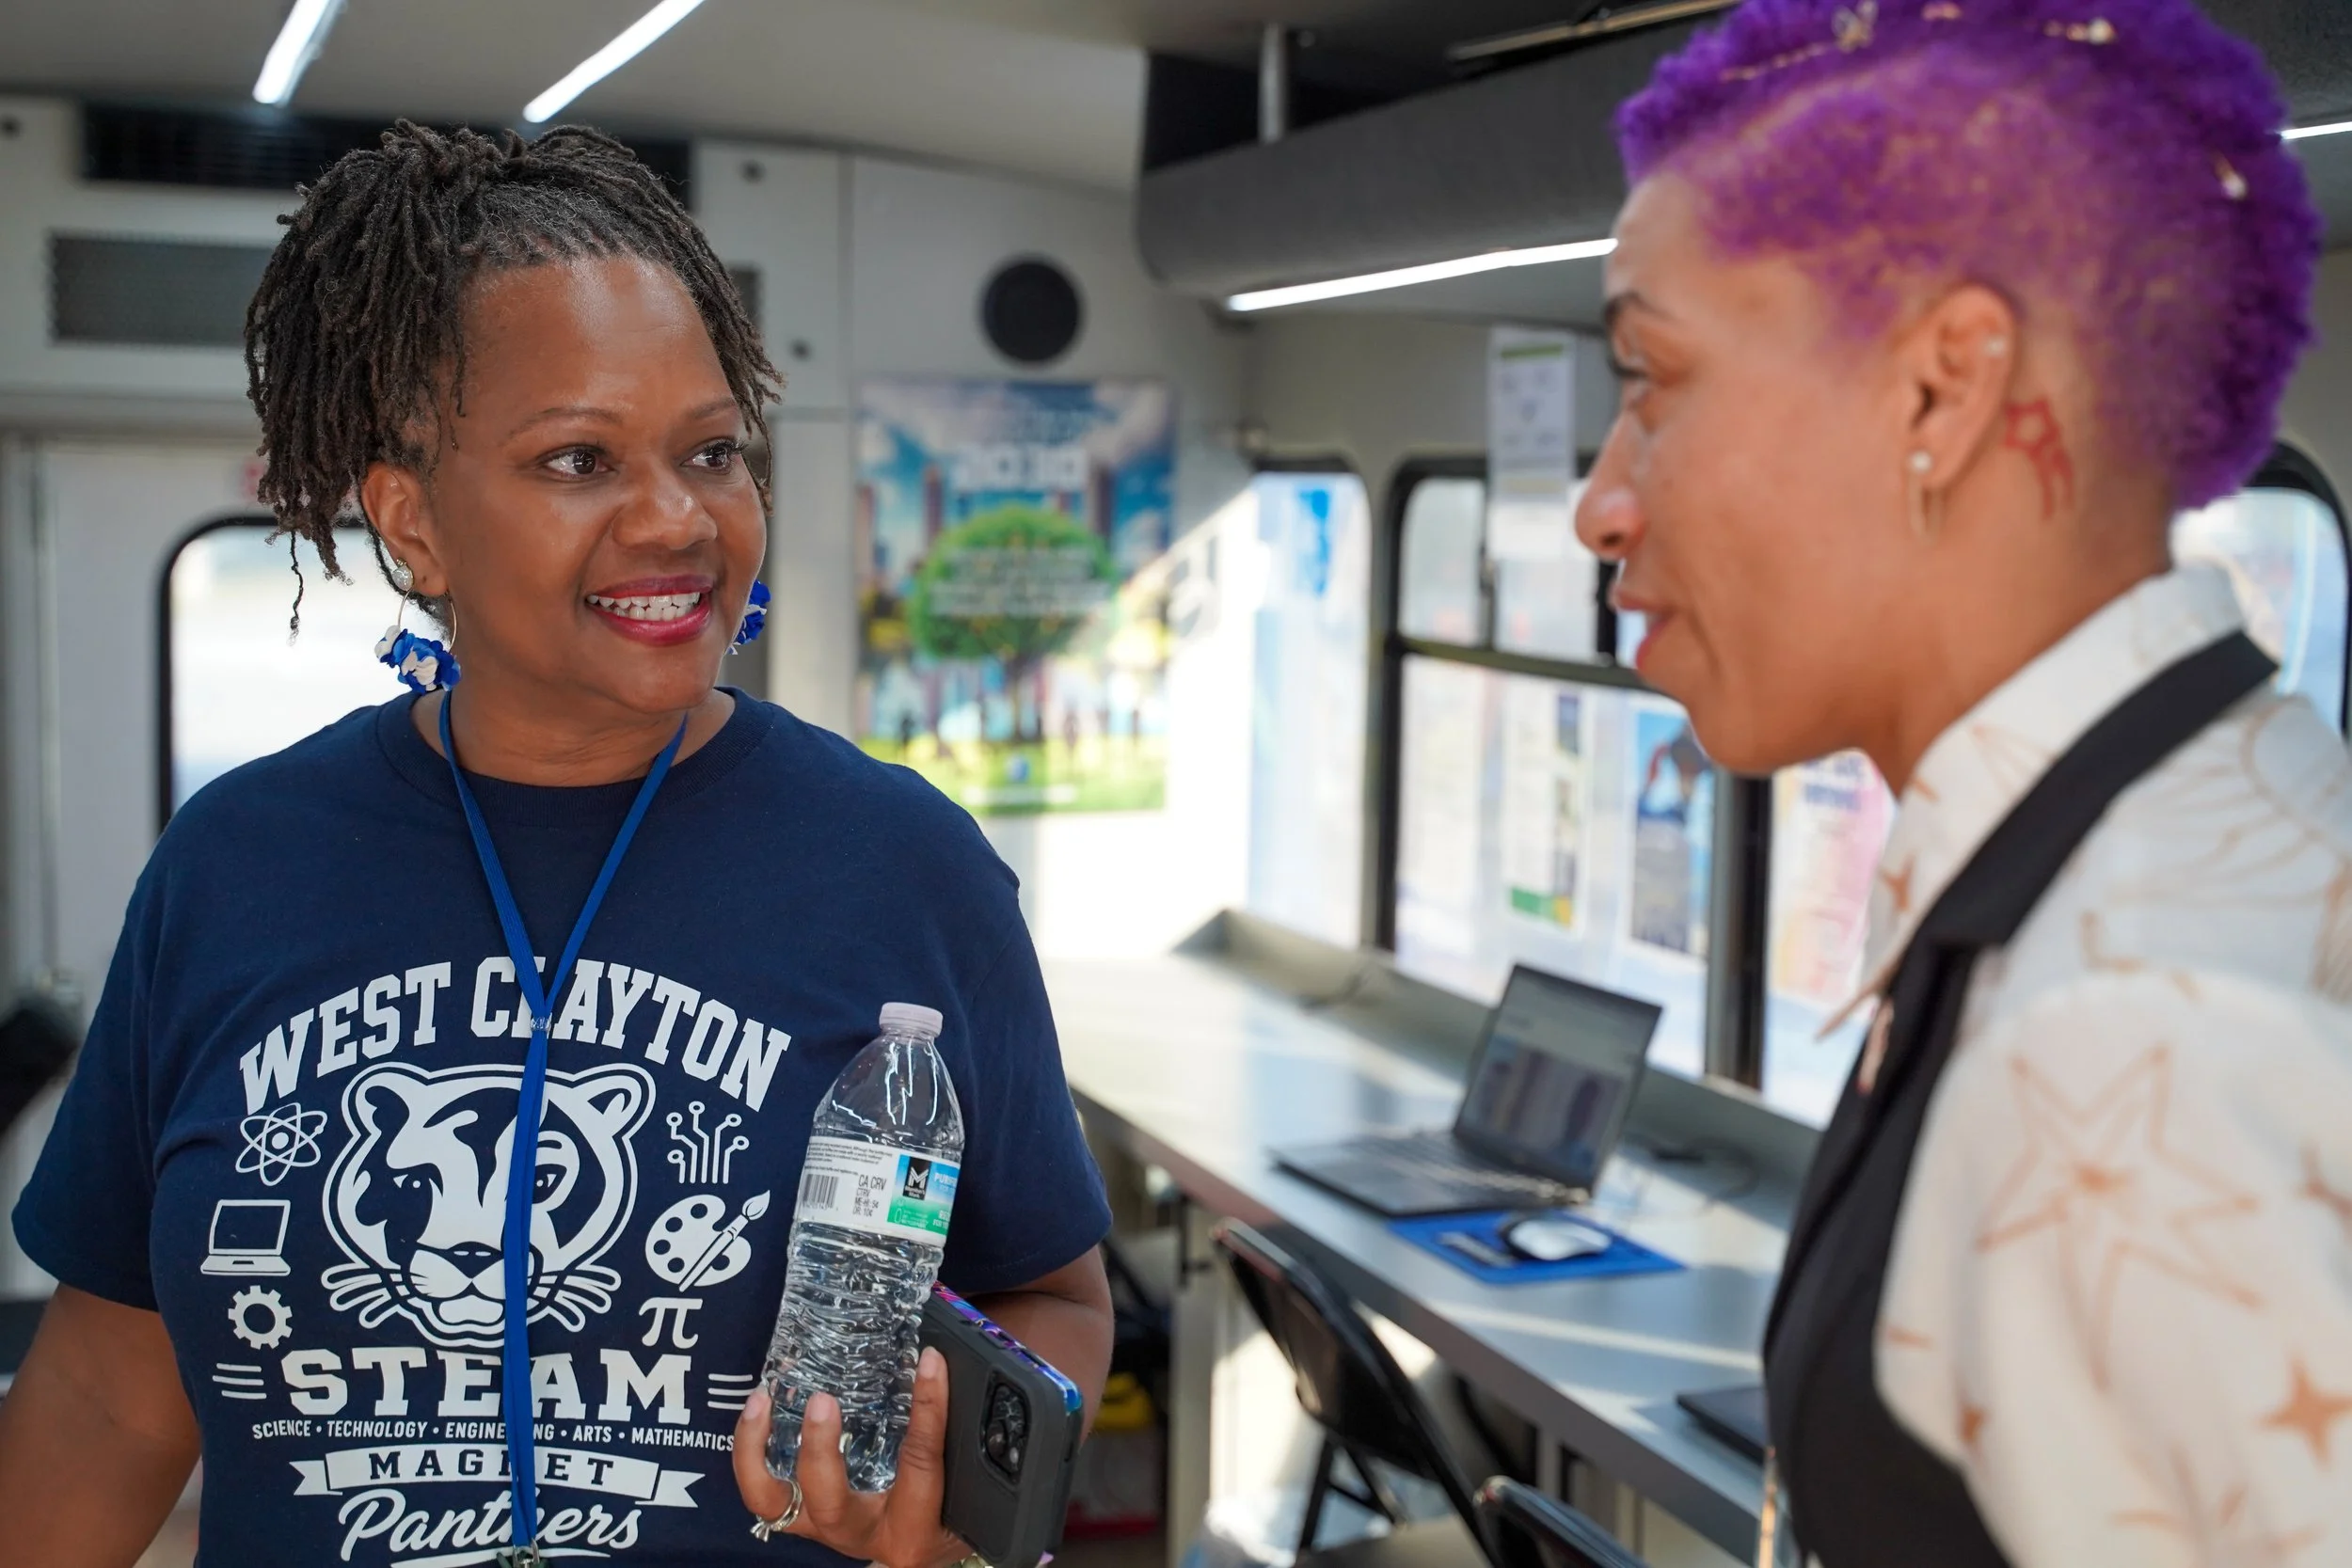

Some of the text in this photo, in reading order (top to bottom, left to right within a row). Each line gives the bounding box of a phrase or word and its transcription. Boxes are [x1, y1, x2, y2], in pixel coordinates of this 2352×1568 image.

[239, 960, 452, 1117] WEST
[858, 1174, 887, 1191] CA CRV
[280, 1346, 692, 1426] STEAM
[251, 1418, 734, 1451] SCIENCE TECHNOLOGY ENGINENG ARTS MATHEMATICS
